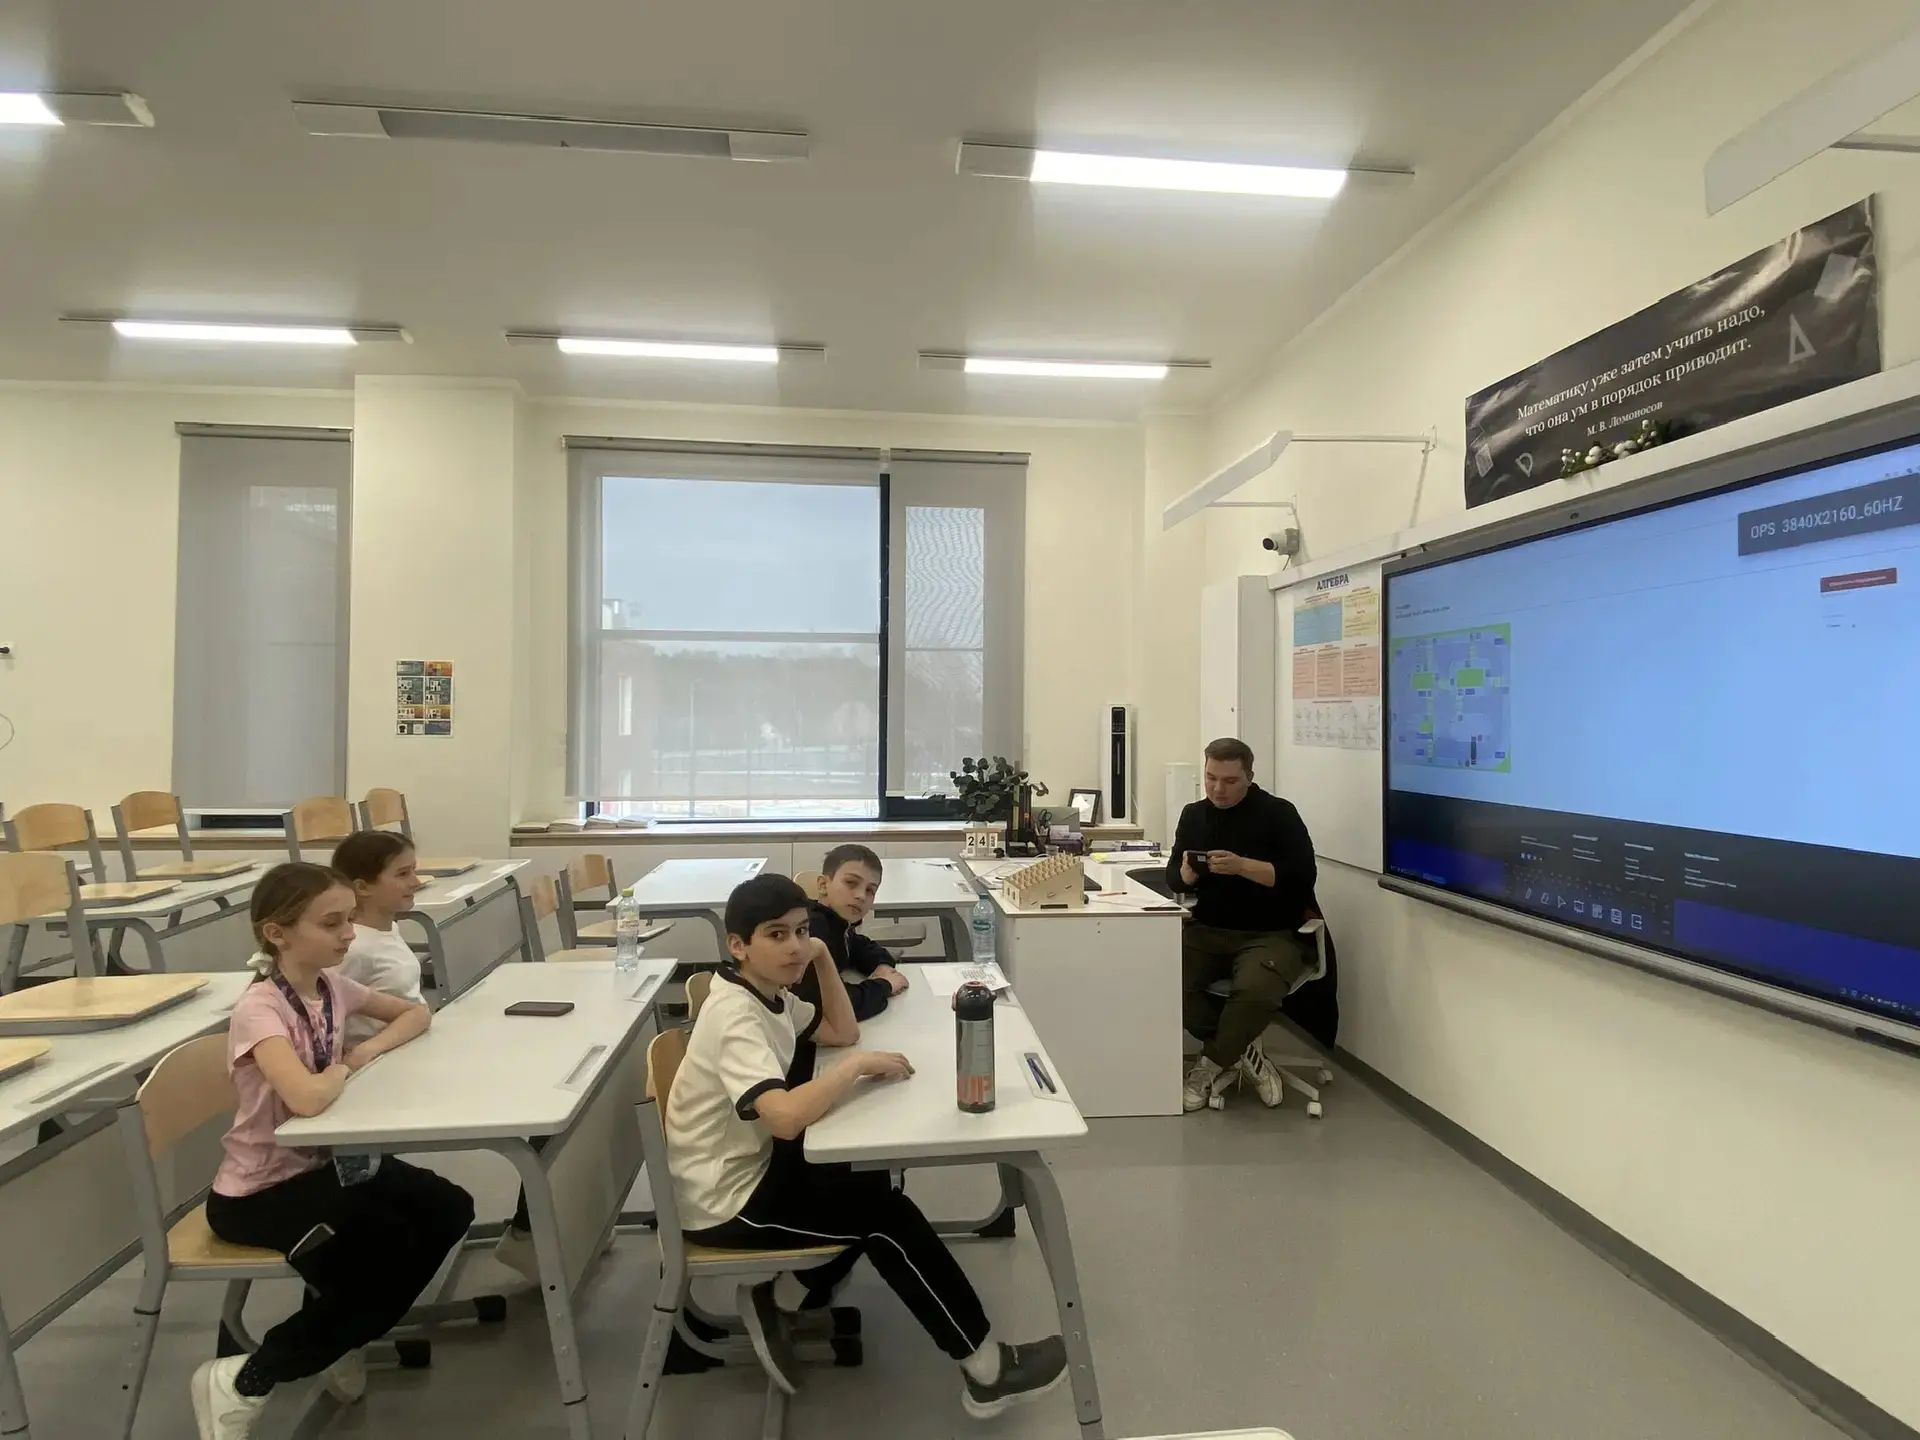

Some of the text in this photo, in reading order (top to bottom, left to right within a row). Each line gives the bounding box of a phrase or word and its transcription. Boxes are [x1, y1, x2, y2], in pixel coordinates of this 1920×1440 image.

[1517, 305, 1766, 420] Математику уже затем учить надо,
[1525, 337, 1752, 437] что она ум в порядок приводит.
[1586, 401, 1663, 437] М. В. Ломоносов
[1750, 495, 1904, 539] OPS 3840X2160_60HZ
[1317, 574, 1349, 590] АЛГЕБРА
